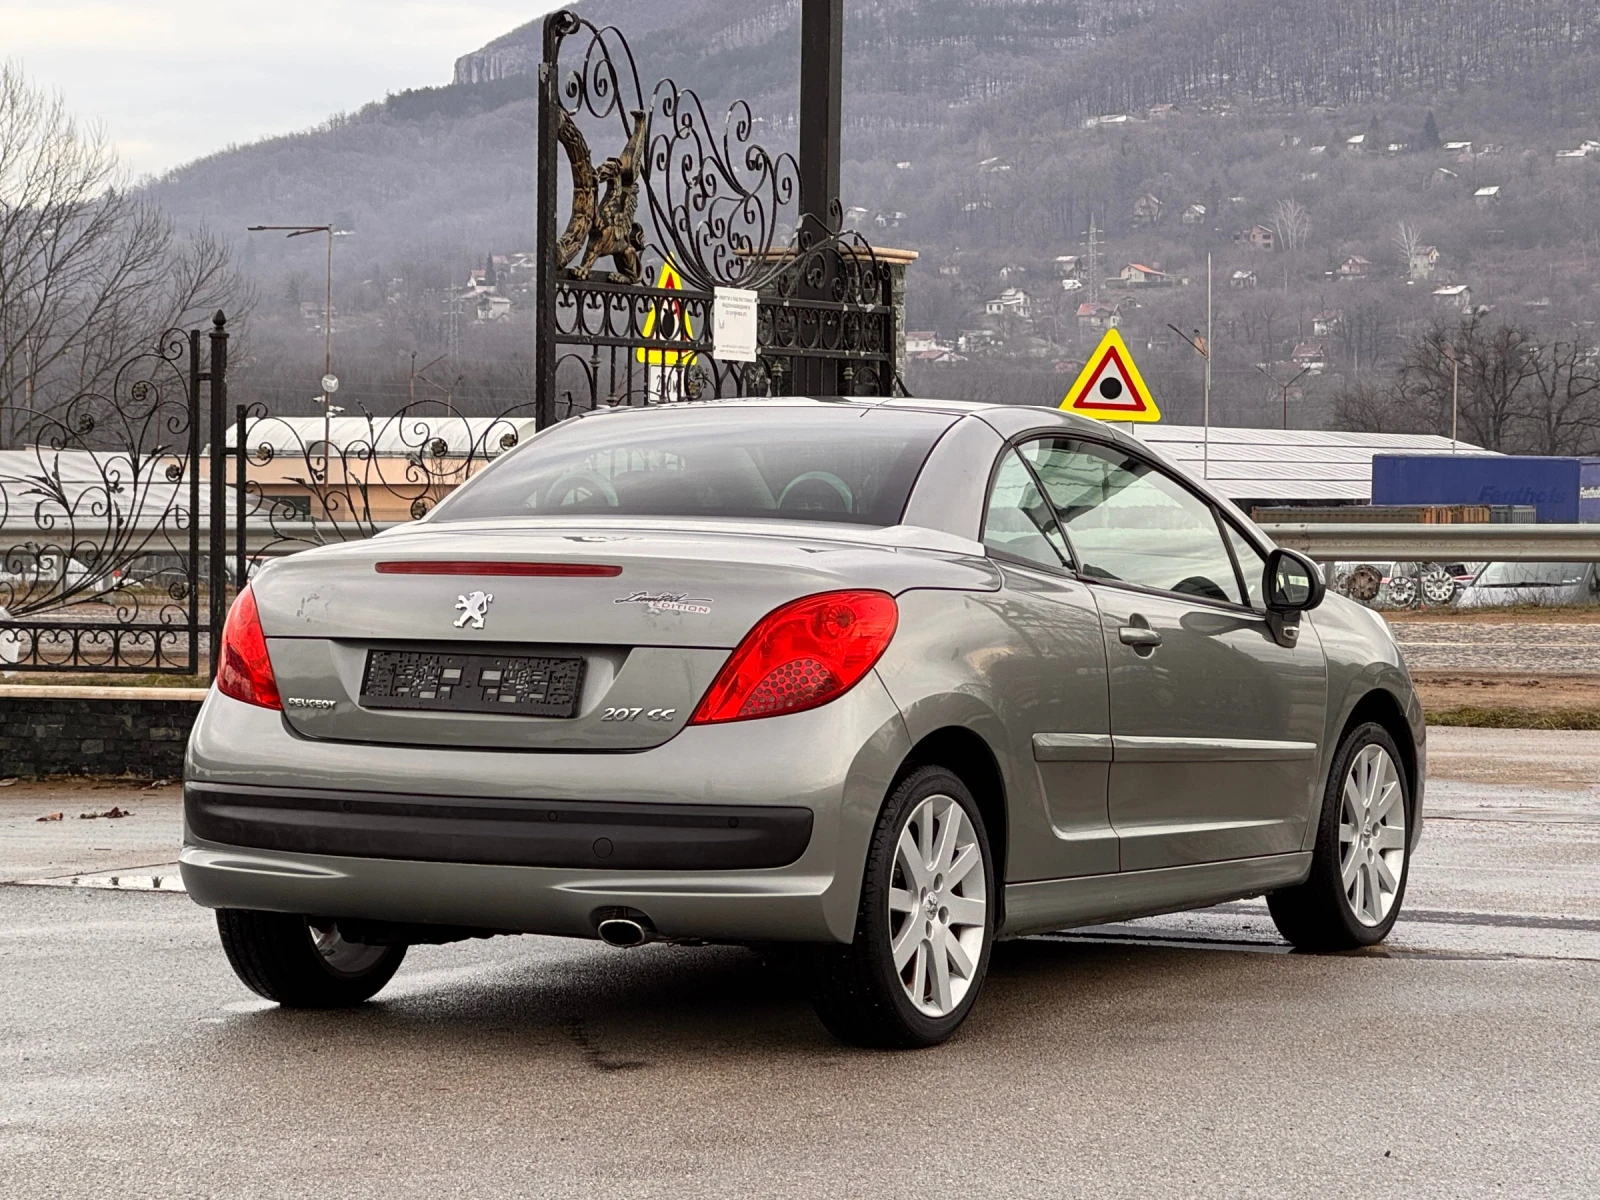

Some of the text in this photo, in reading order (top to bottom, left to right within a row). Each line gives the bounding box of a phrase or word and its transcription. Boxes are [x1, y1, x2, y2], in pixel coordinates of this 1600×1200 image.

[652, 601, 708, 613] EDITION
[288, 697, 337, 710] PEUGEOT
[601, 707, 676, 721] 207 CC
